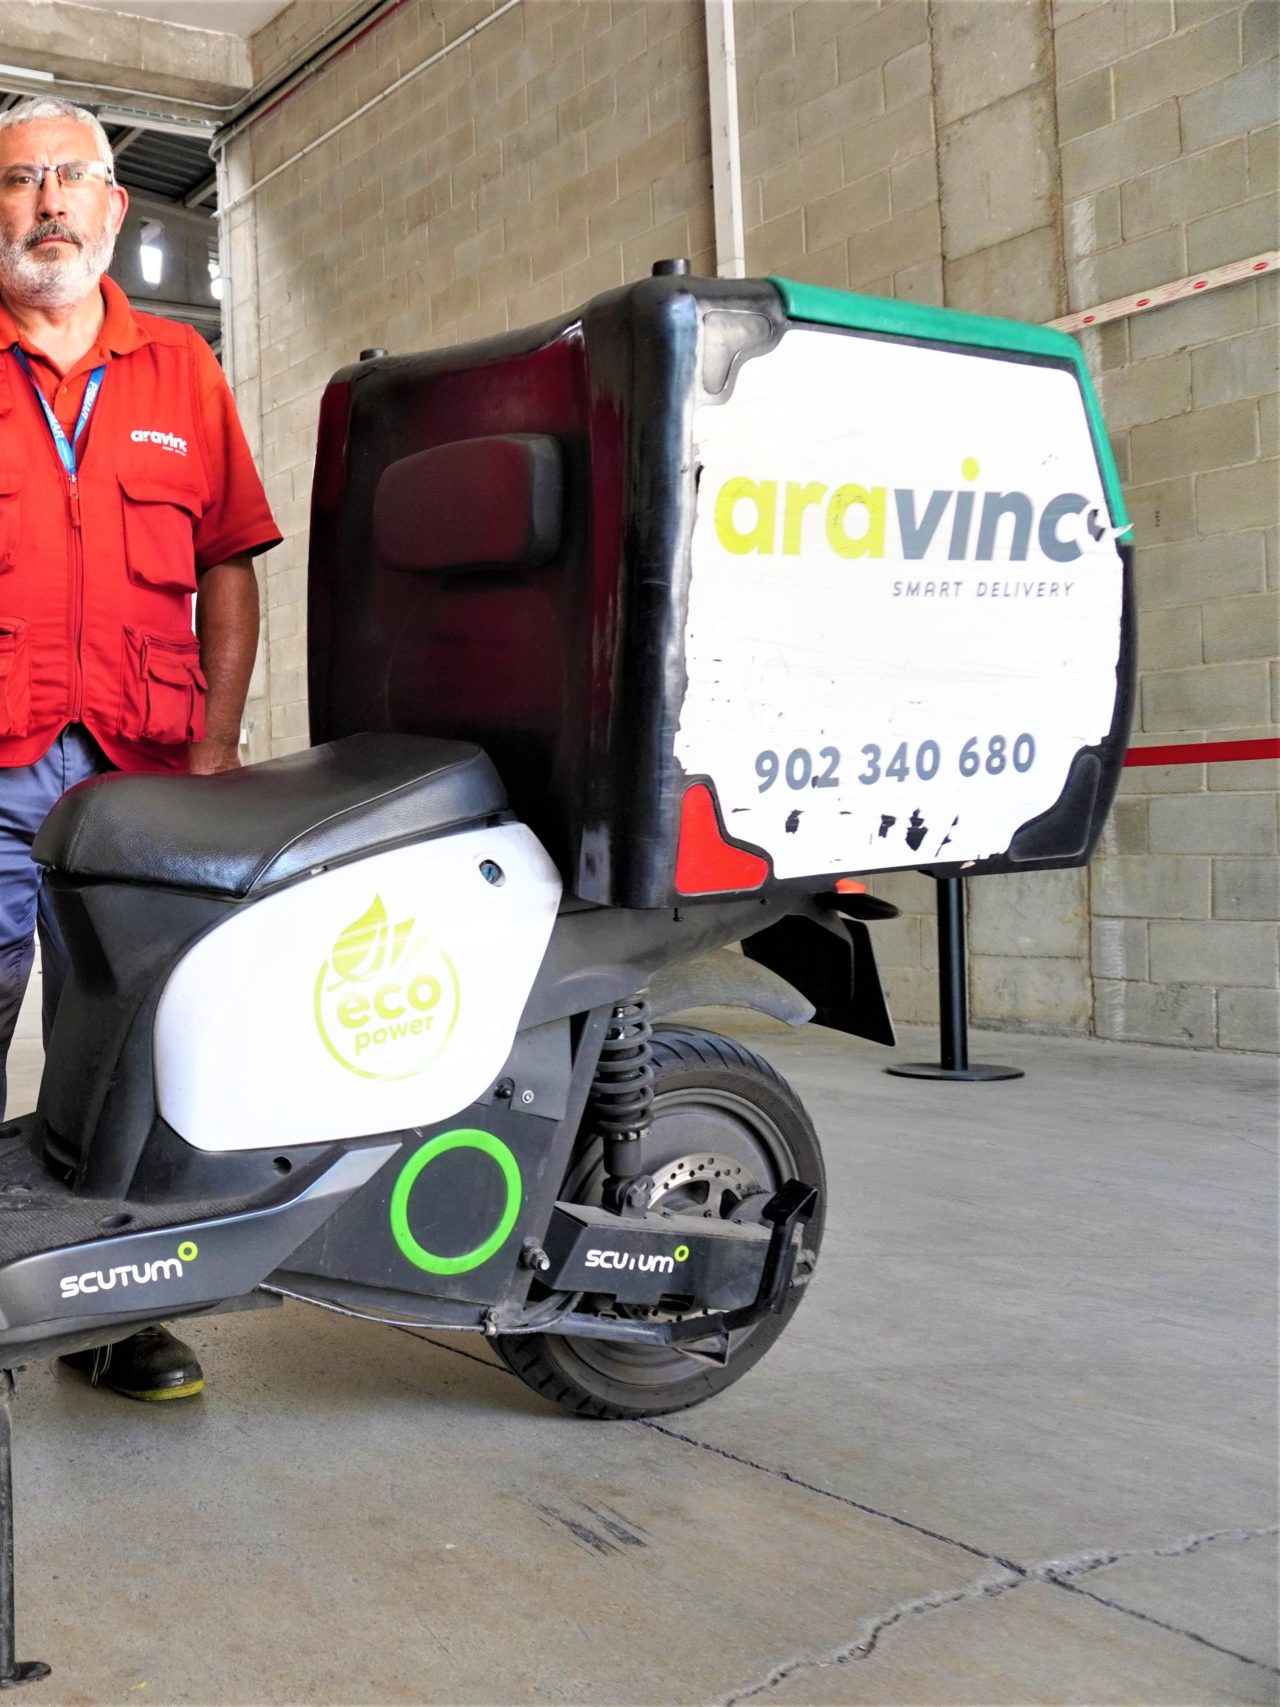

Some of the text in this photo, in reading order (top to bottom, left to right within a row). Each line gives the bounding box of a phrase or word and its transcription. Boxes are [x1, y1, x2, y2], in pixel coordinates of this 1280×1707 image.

[714, 456, 1091, 563] aravinc
[892, 581, 1074, 598] SMART DELIVERY
[754, 732, 1036, 794] 902 340 680
[336, 974, 442, 1030] eco
[354, 1014, 434, 1056] power
